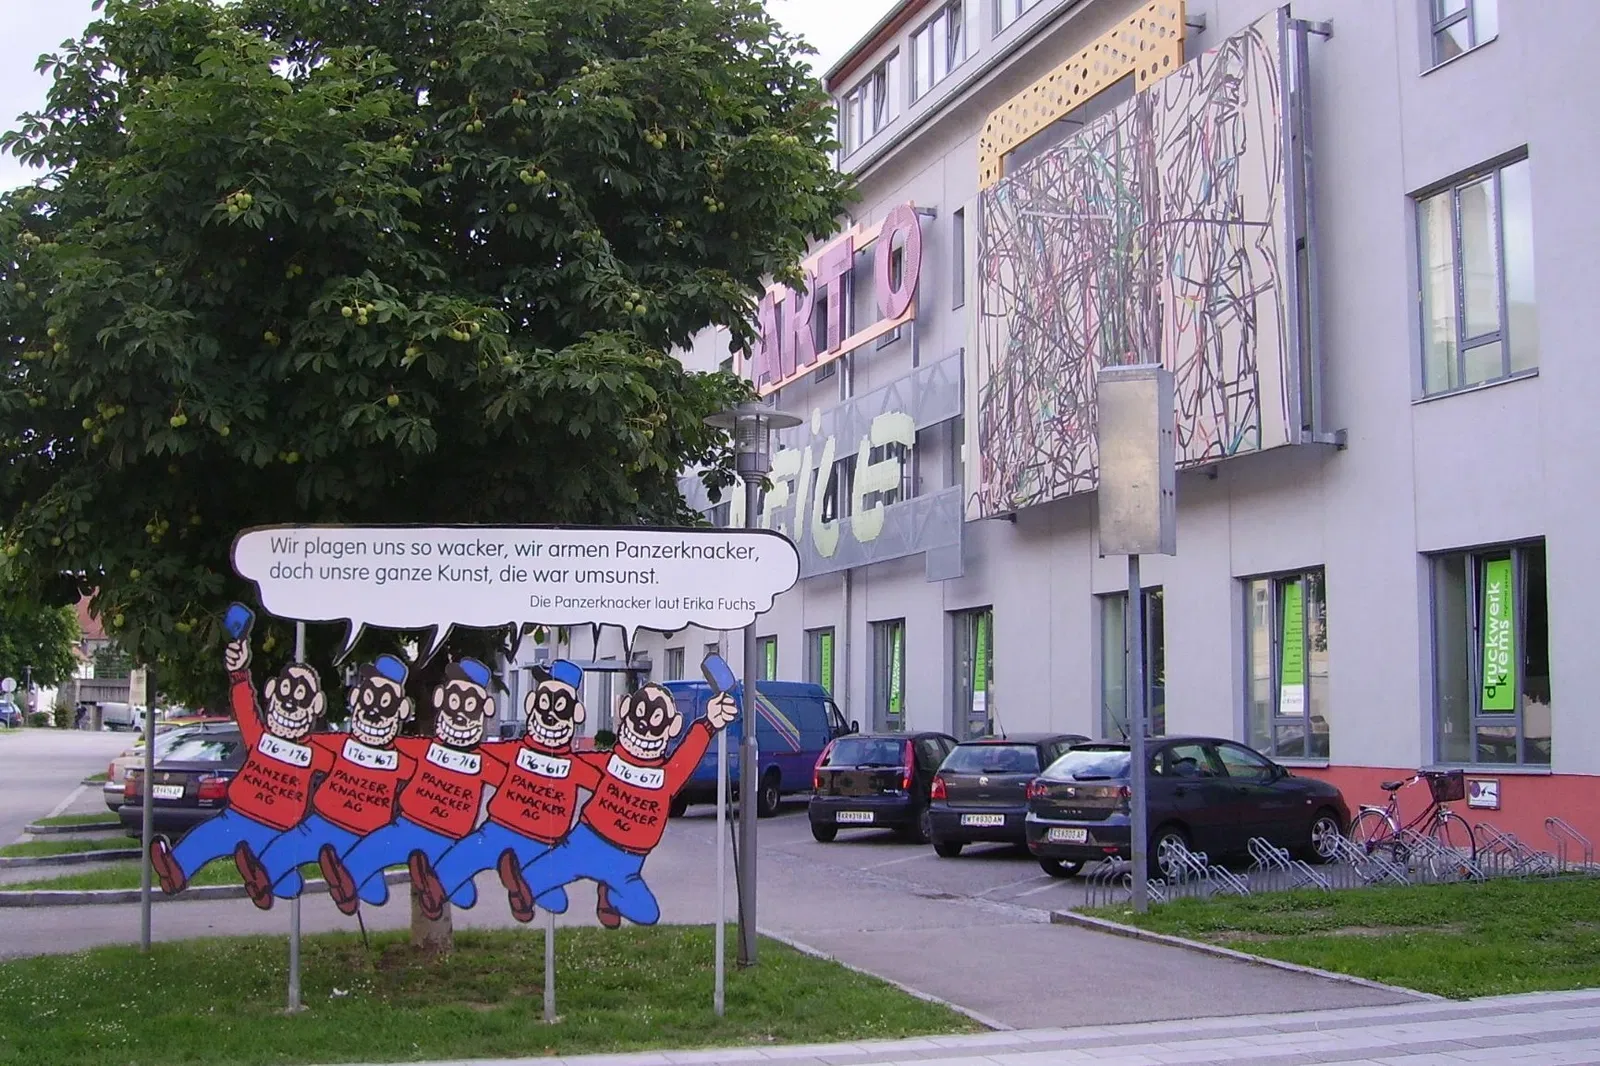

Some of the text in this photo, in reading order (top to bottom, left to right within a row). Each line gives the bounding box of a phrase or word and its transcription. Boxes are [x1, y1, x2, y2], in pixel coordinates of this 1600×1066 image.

[270, 536, 760, 563] Wir plagen uns so wacker, wir armen Panzerknacker,
[269, 561, 659, 585] doch unsre ganze Kunst, die war umsunst.
[530, 595, 757, 611] Die Panzerknacker laut Erika Fuchs
[1485, 581, 1501, 699] druckwerk
[1496, 620, 1510, 687] krems
[260, 739, 309, 762] 176-176
[430, 747, 477, 769] 176-716
[521, 755, 568, 775] 176-617
[615, 764, 661, 785] 176-671
[243, 774, 304, 803] KNACKER
[254, 792, 274, 805] AG
[329, 781, 390, 808] KNACKER
[416, 786, 471, 812] KNACKER
[342, 799, 363, 813] AG
[430, 805, 449, 818] AG
[506, 789, 566, 817] KNACKER
[522, 808, 540, 821] AG
[599, 796, 658, 827] KNACKER
[614, 818, 631, 832] AG
